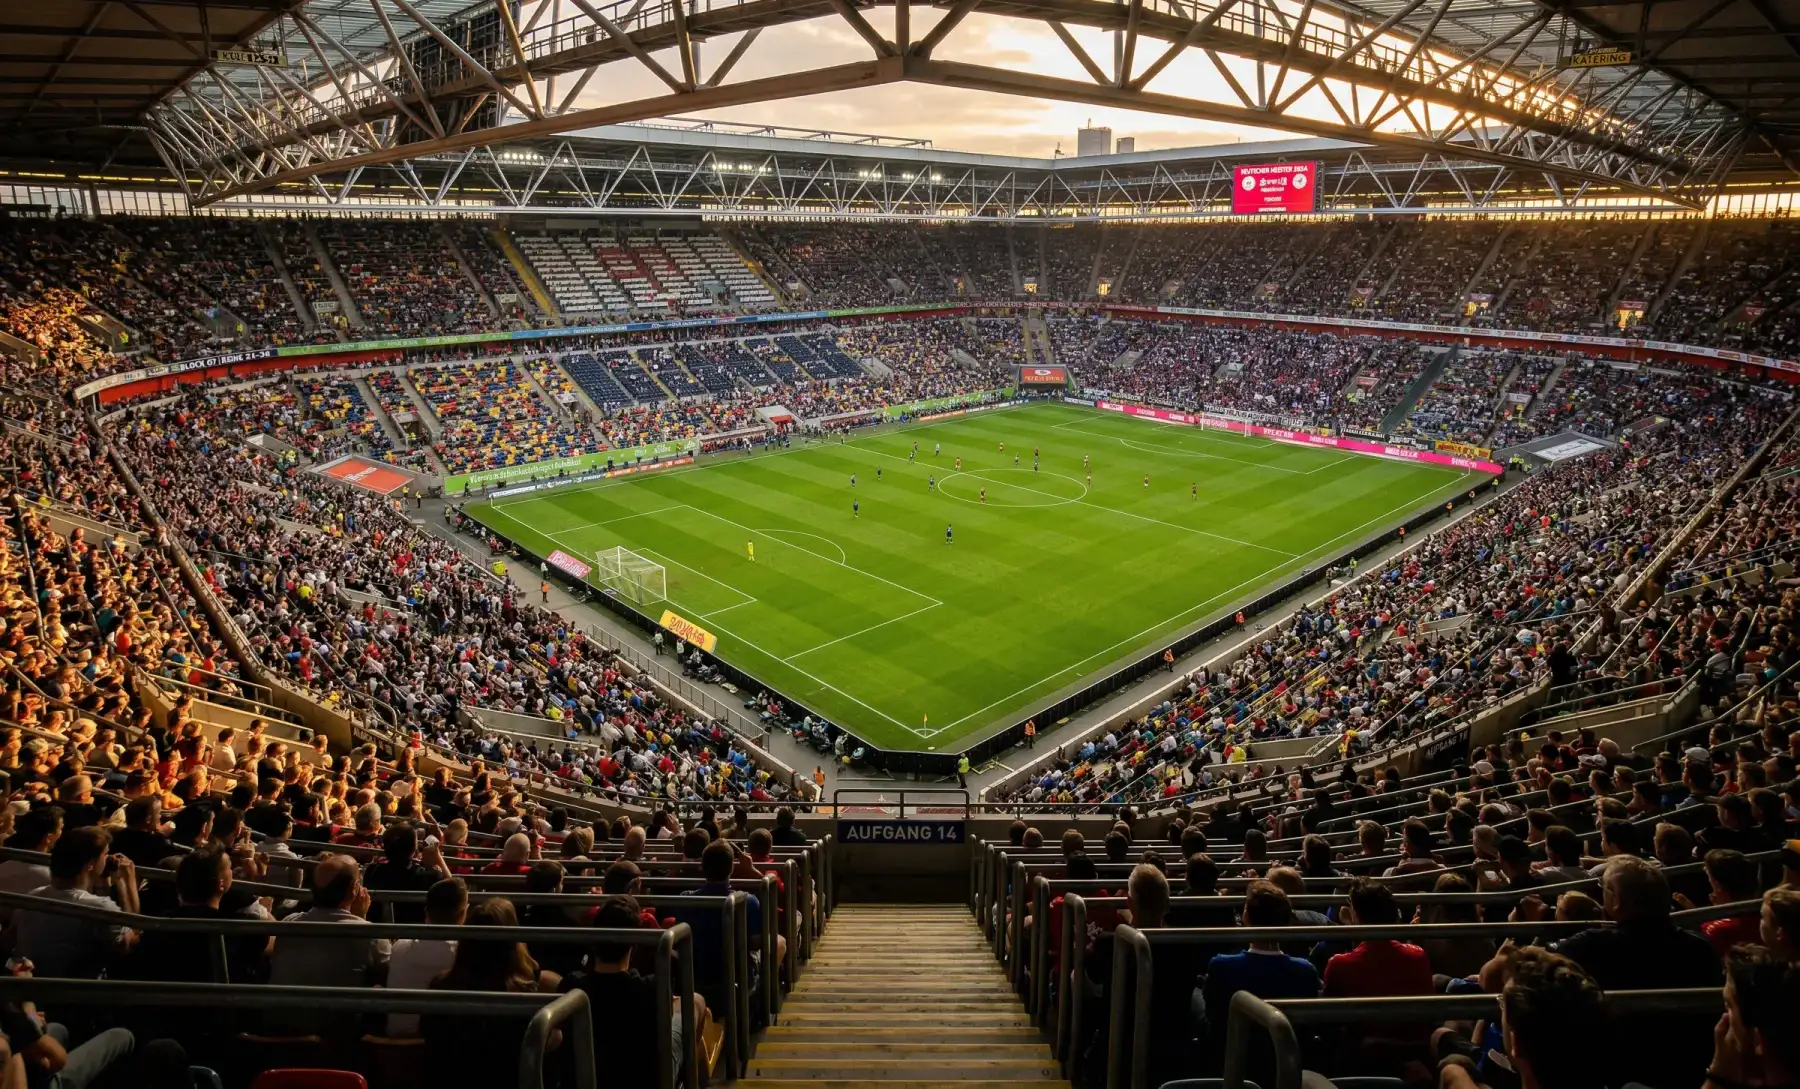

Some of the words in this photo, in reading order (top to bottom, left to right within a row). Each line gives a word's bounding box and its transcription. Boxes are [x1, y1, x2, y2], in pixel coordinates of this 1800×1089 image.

[180, 359, 205, 371] BLOCK
[846, 825, 932, 840] AUFGANG
[938, 825, 957, 840] 14
